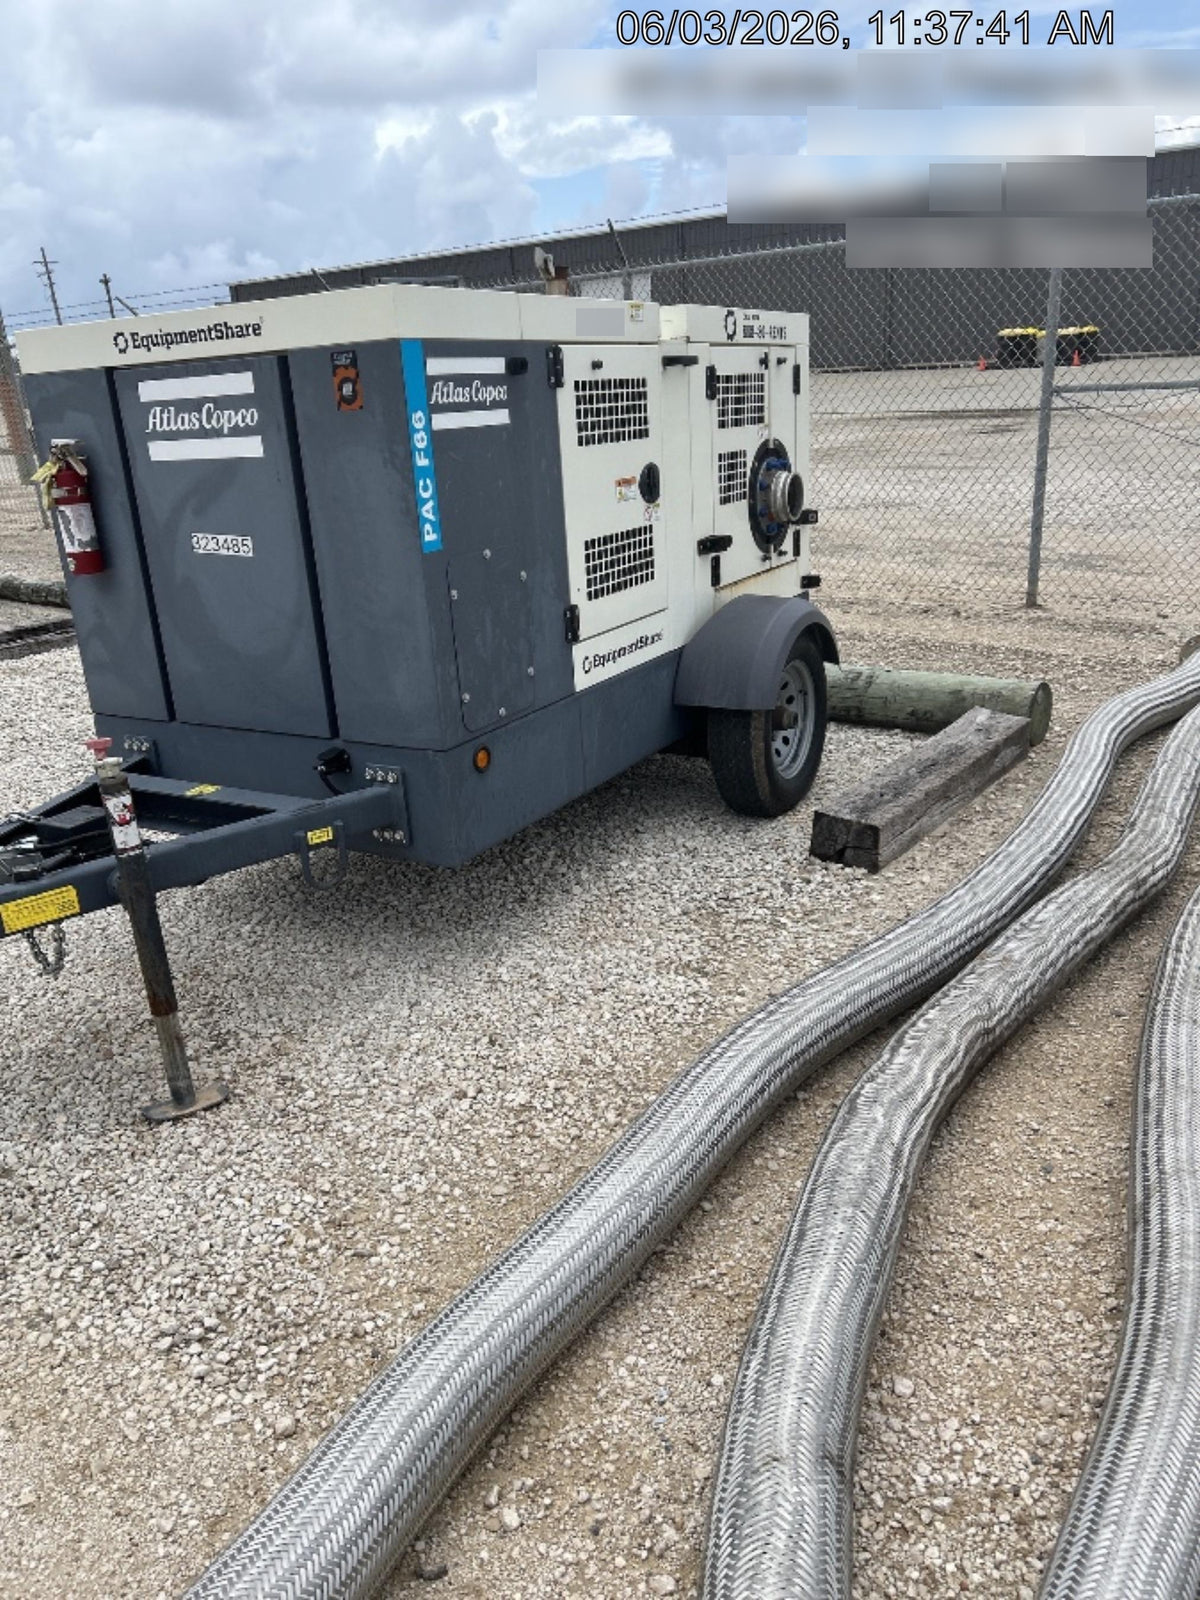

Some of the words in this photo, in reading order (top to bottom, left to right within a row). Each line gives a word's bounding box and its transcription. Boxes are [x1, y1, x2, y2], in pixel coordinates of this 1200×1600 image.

[130, 320, 262, 352] EquipmentShare
[429, 380, 470, 404] Atlas
[471, 380, 508, 406] Copco
[145, 406, 200, 433] Atlas
[202, 403, 259, 434] Copco
[412, 410, 430, 467] F66
[418, 477, 438, 542] PAC
[191, 534, 252, 555] 323485
